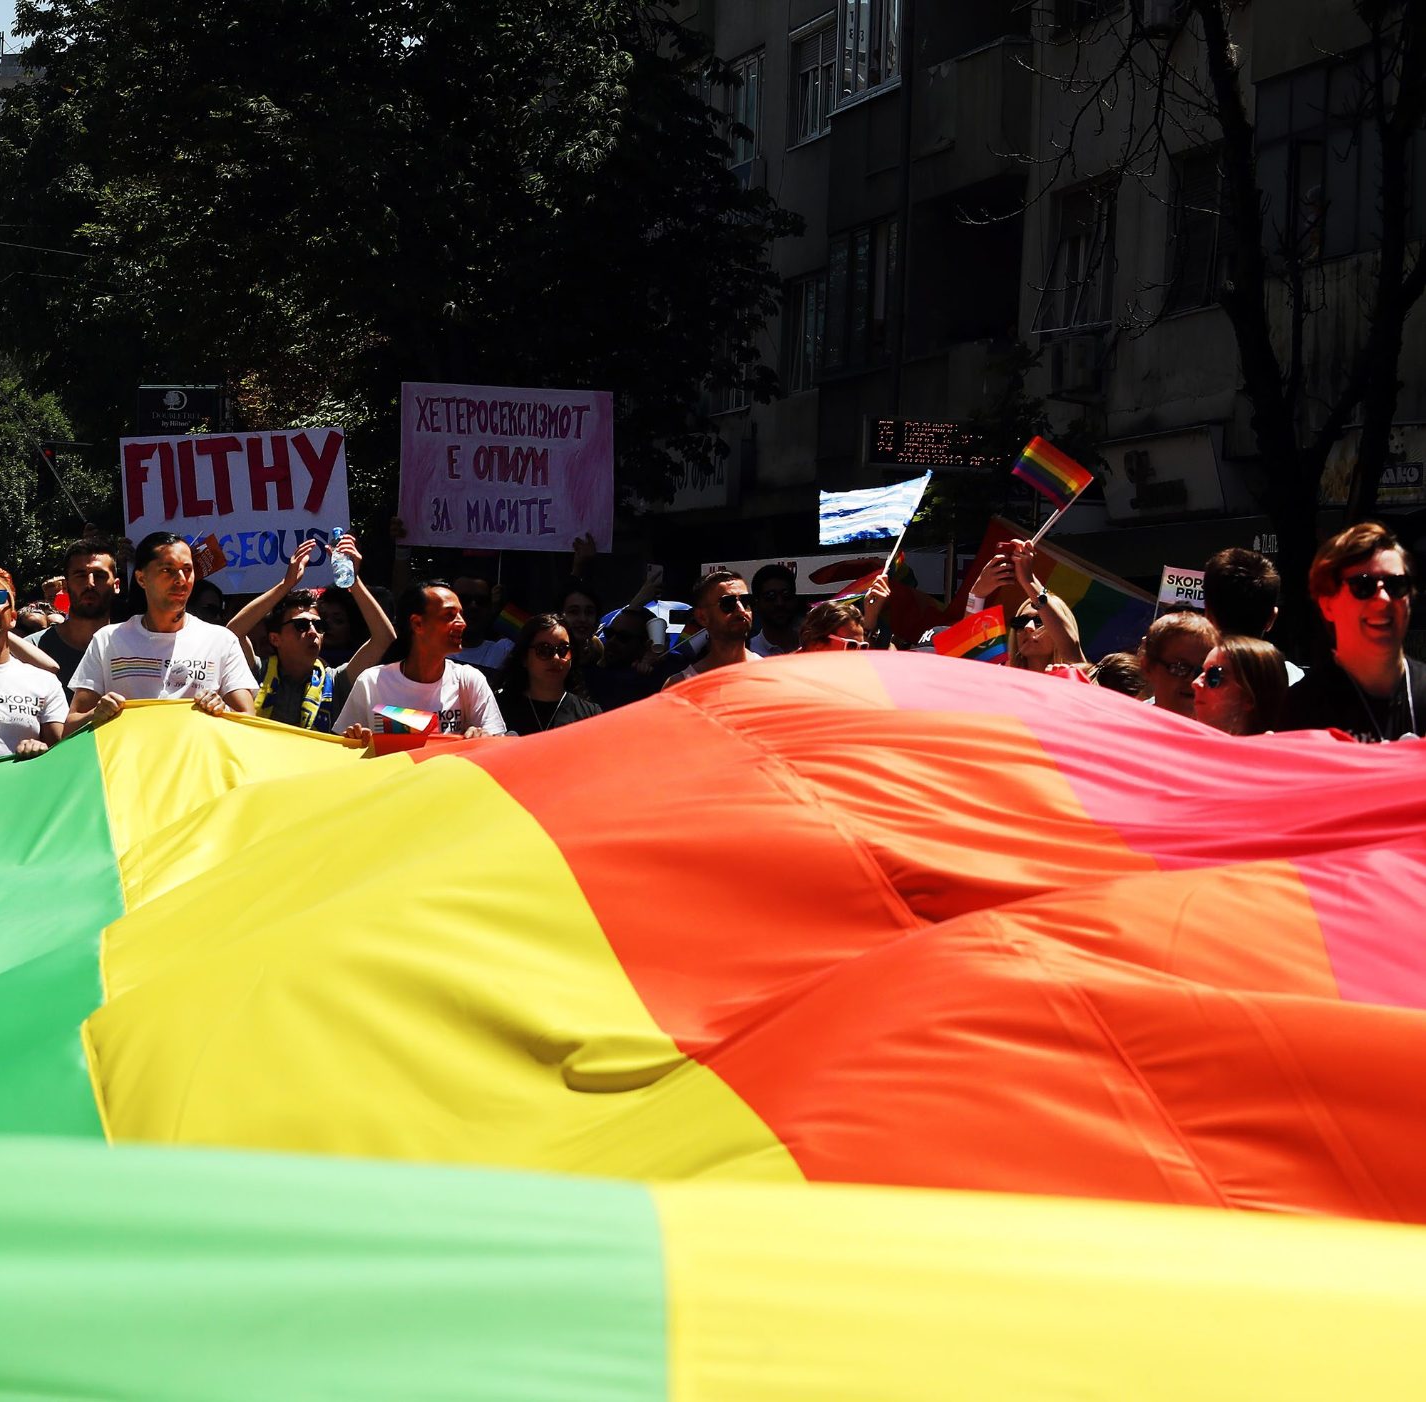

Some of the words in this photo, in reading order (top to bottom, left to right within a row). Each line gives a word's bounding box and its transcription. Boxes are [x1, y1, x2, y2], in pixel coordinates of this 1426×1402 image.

[415, 396, 591, 439] ХЕТЕРОСЕКСИЗМОТ
[124, 430, 344, 525] FILTHY
[447, 445, 461, 479] Е
[473, 445, 549, 487] ОПИУМ
[430, 497, 454, 532] ЗА
[466, 497, 556, 535] МАСИТЕ
